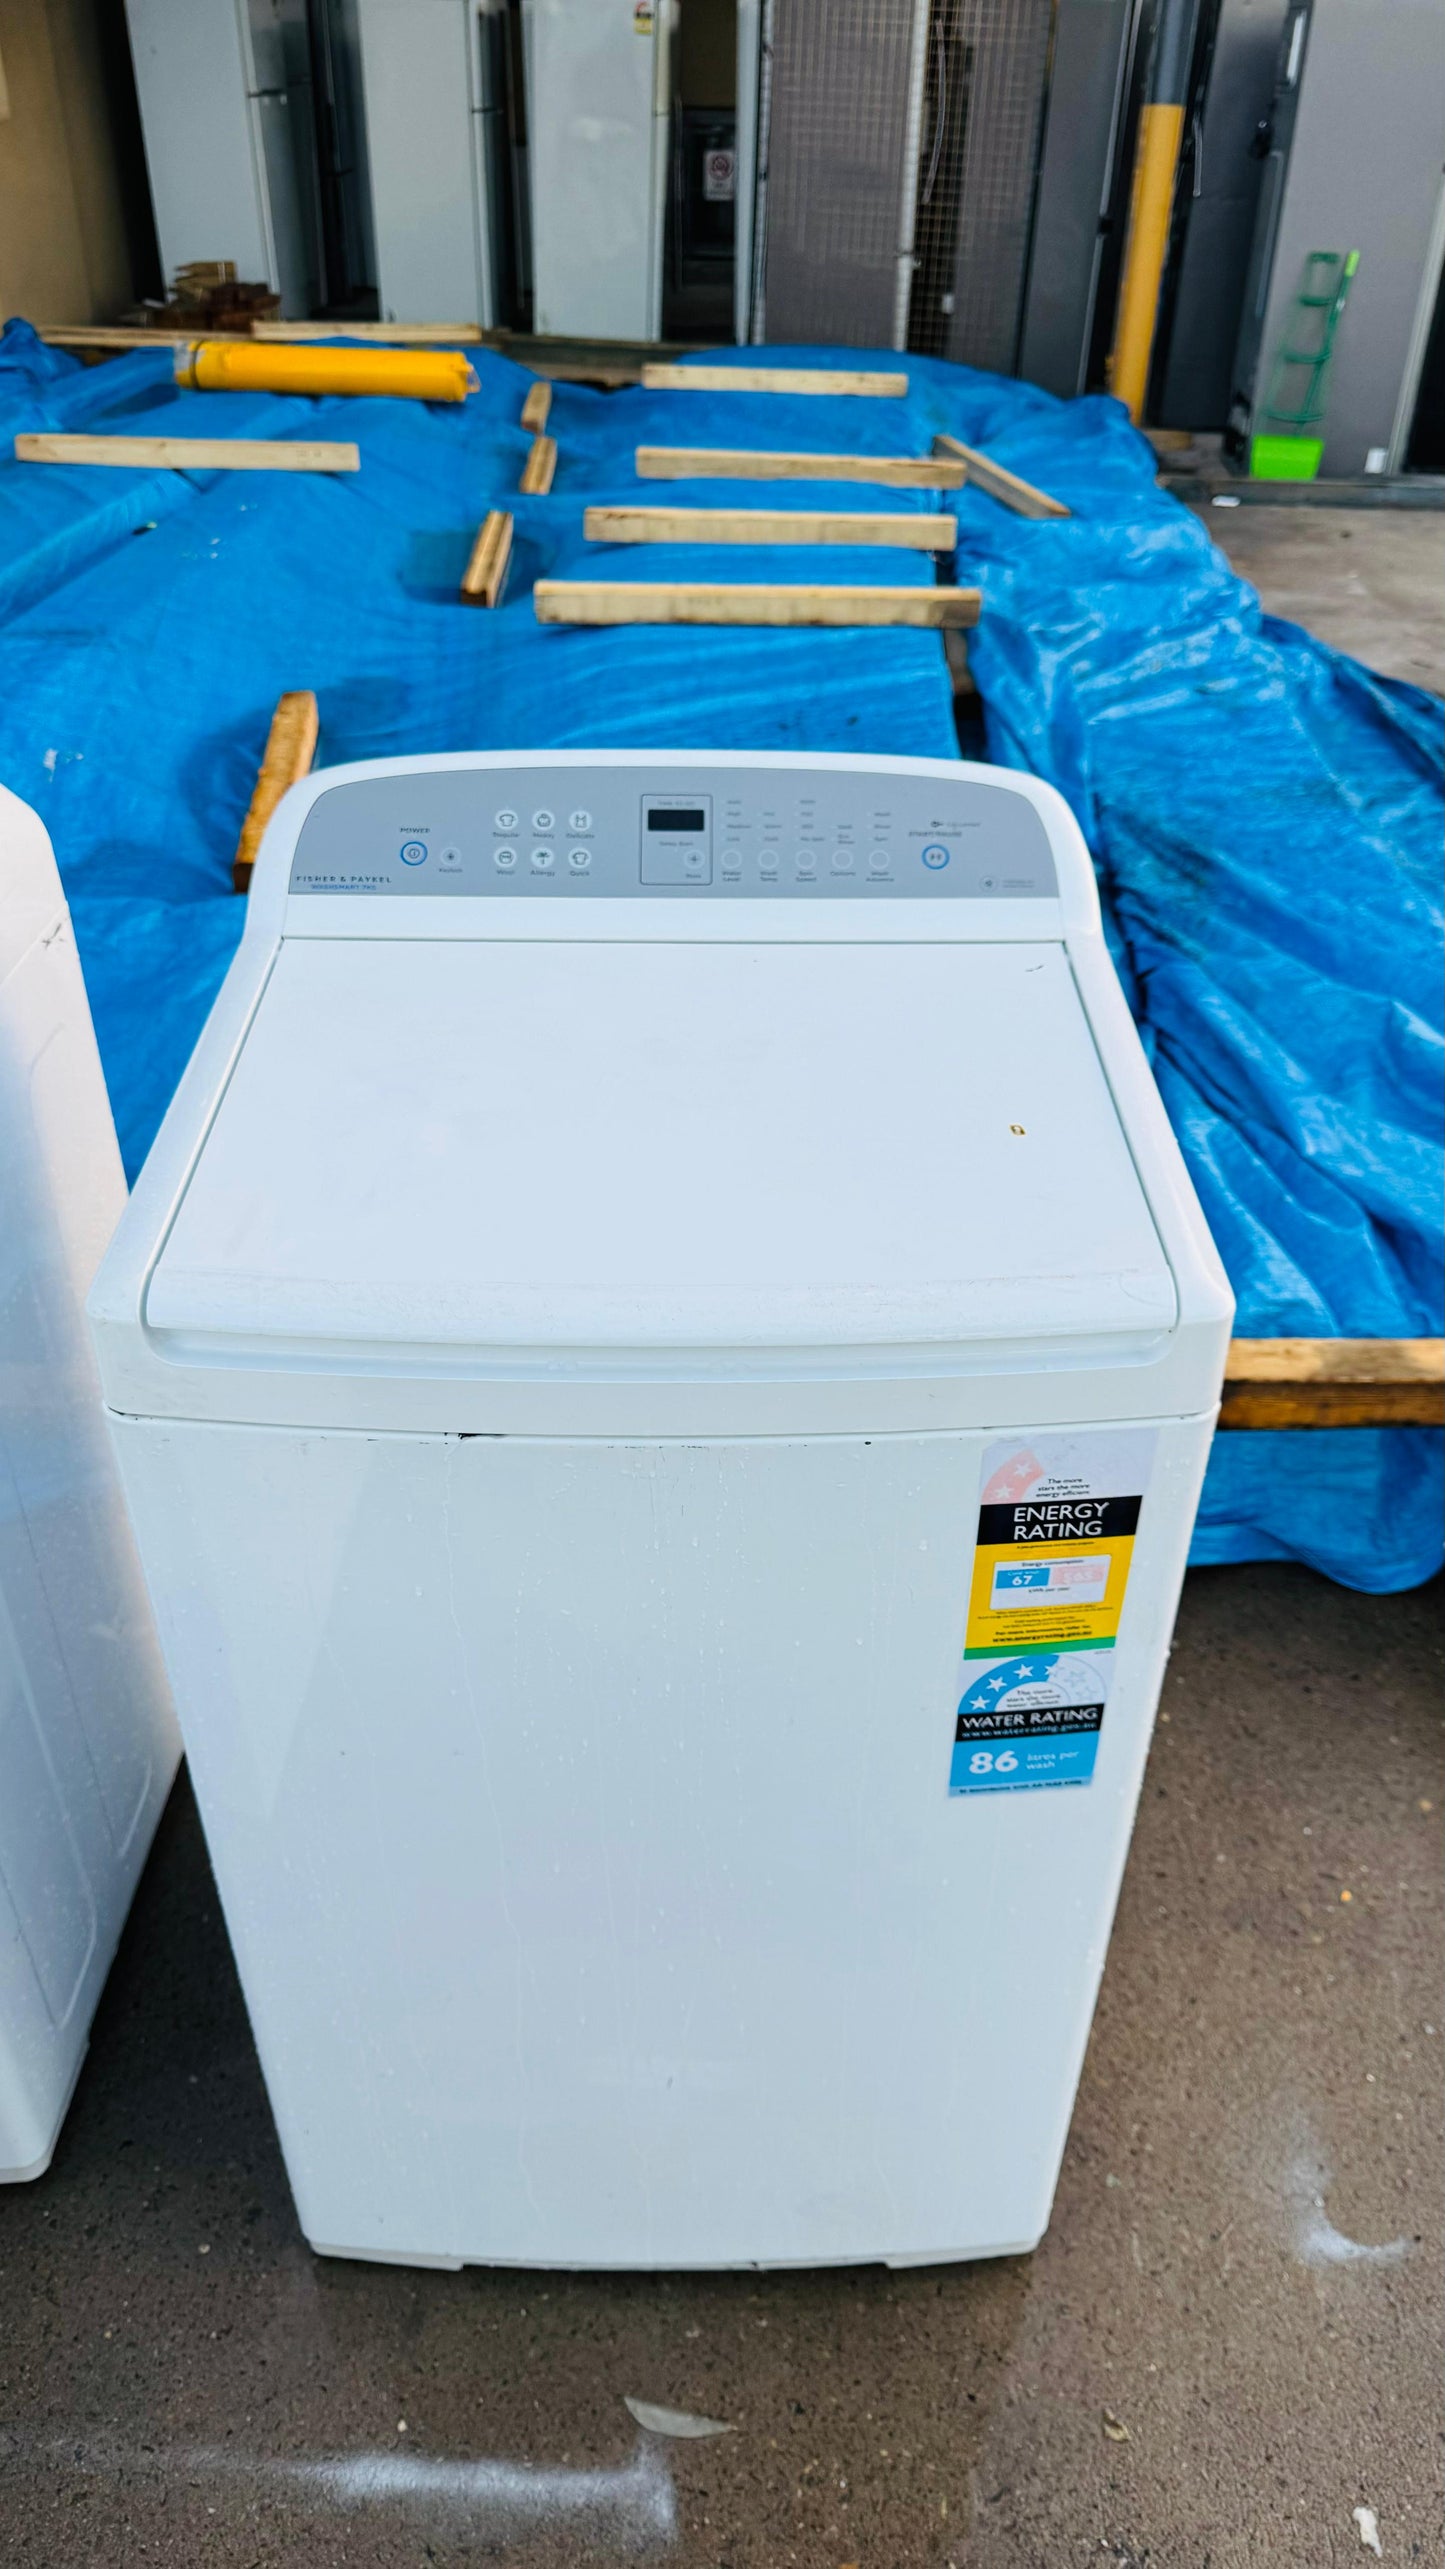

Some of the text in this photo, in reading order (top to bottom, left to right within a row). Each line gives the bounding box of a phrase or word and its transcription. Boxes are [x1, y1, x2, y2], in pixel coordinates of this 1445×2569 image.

[351, 876, 393, 884] PAYKEL
[1013, 1502, 1110, 1523] ENERGY
[1013, 1520, 1104, 1541] RATING
[1012, 1575, 1033, 1586] 67
[962, 1707, 1098, 1729] WATER RATING
[969, 1750, 1019, 1774] 86
[1059, 1751, 1079, 1760] per
[1025, 1761, 1055, 1770] wash
